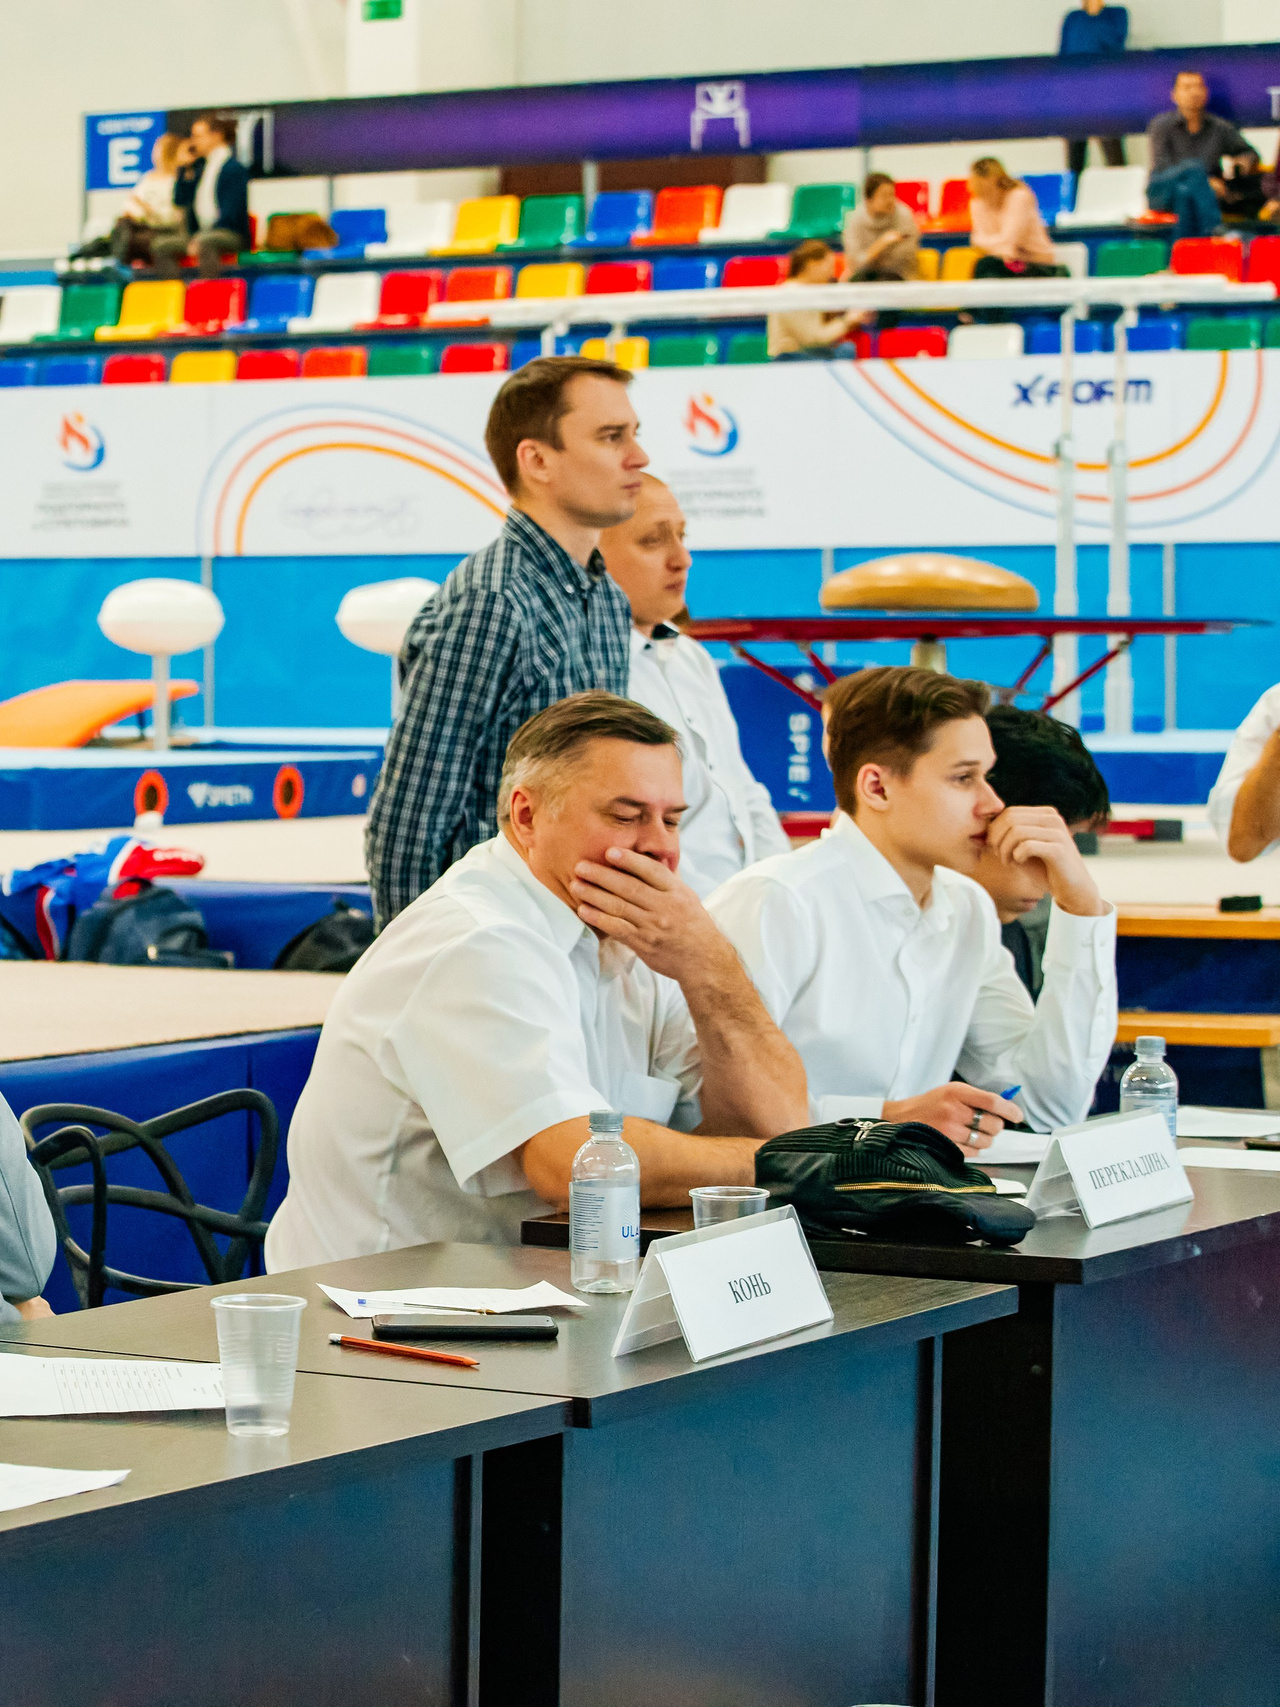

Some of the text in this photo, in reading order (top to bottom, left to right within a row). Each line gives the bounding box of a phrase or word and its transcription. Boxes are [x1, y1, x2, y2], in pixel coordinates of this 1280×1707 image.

[107, 137, 143, 186] E
[1088, 1151, 1170, 1190] ПЕРЕКЛАДИНА
[727, 1272, 772, 1304] КОНЬ
